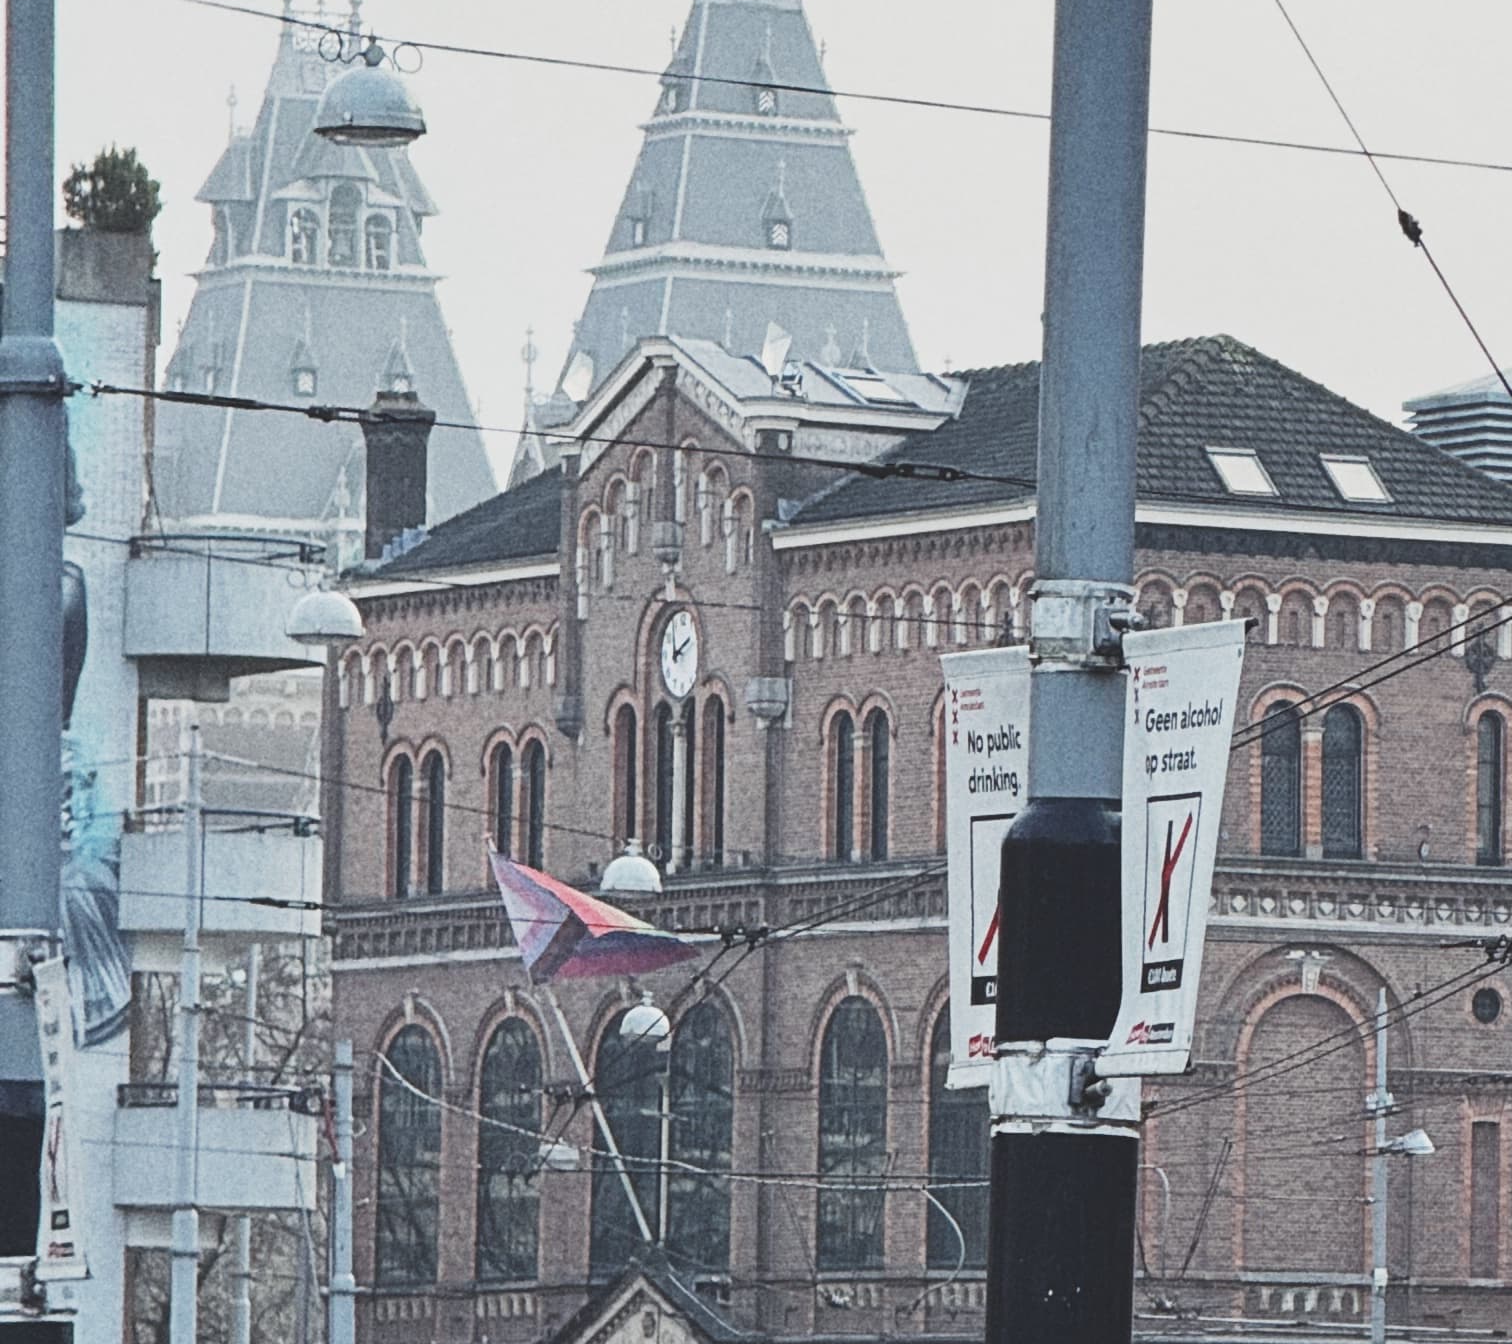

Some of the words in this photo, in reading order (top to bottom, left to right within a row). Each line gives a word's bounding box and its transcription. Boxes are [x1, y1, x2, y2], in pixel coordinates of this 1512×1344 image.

[1145, 708, 1177, 733] Geen
[1180, 698, 1223, 730] alcohol
[967, 729, 984, 754] No
[987, 723, 1021, 759] public
[1161, 746, 1197, 772] straat.
[968, 765, 1021, 797] drinking.
